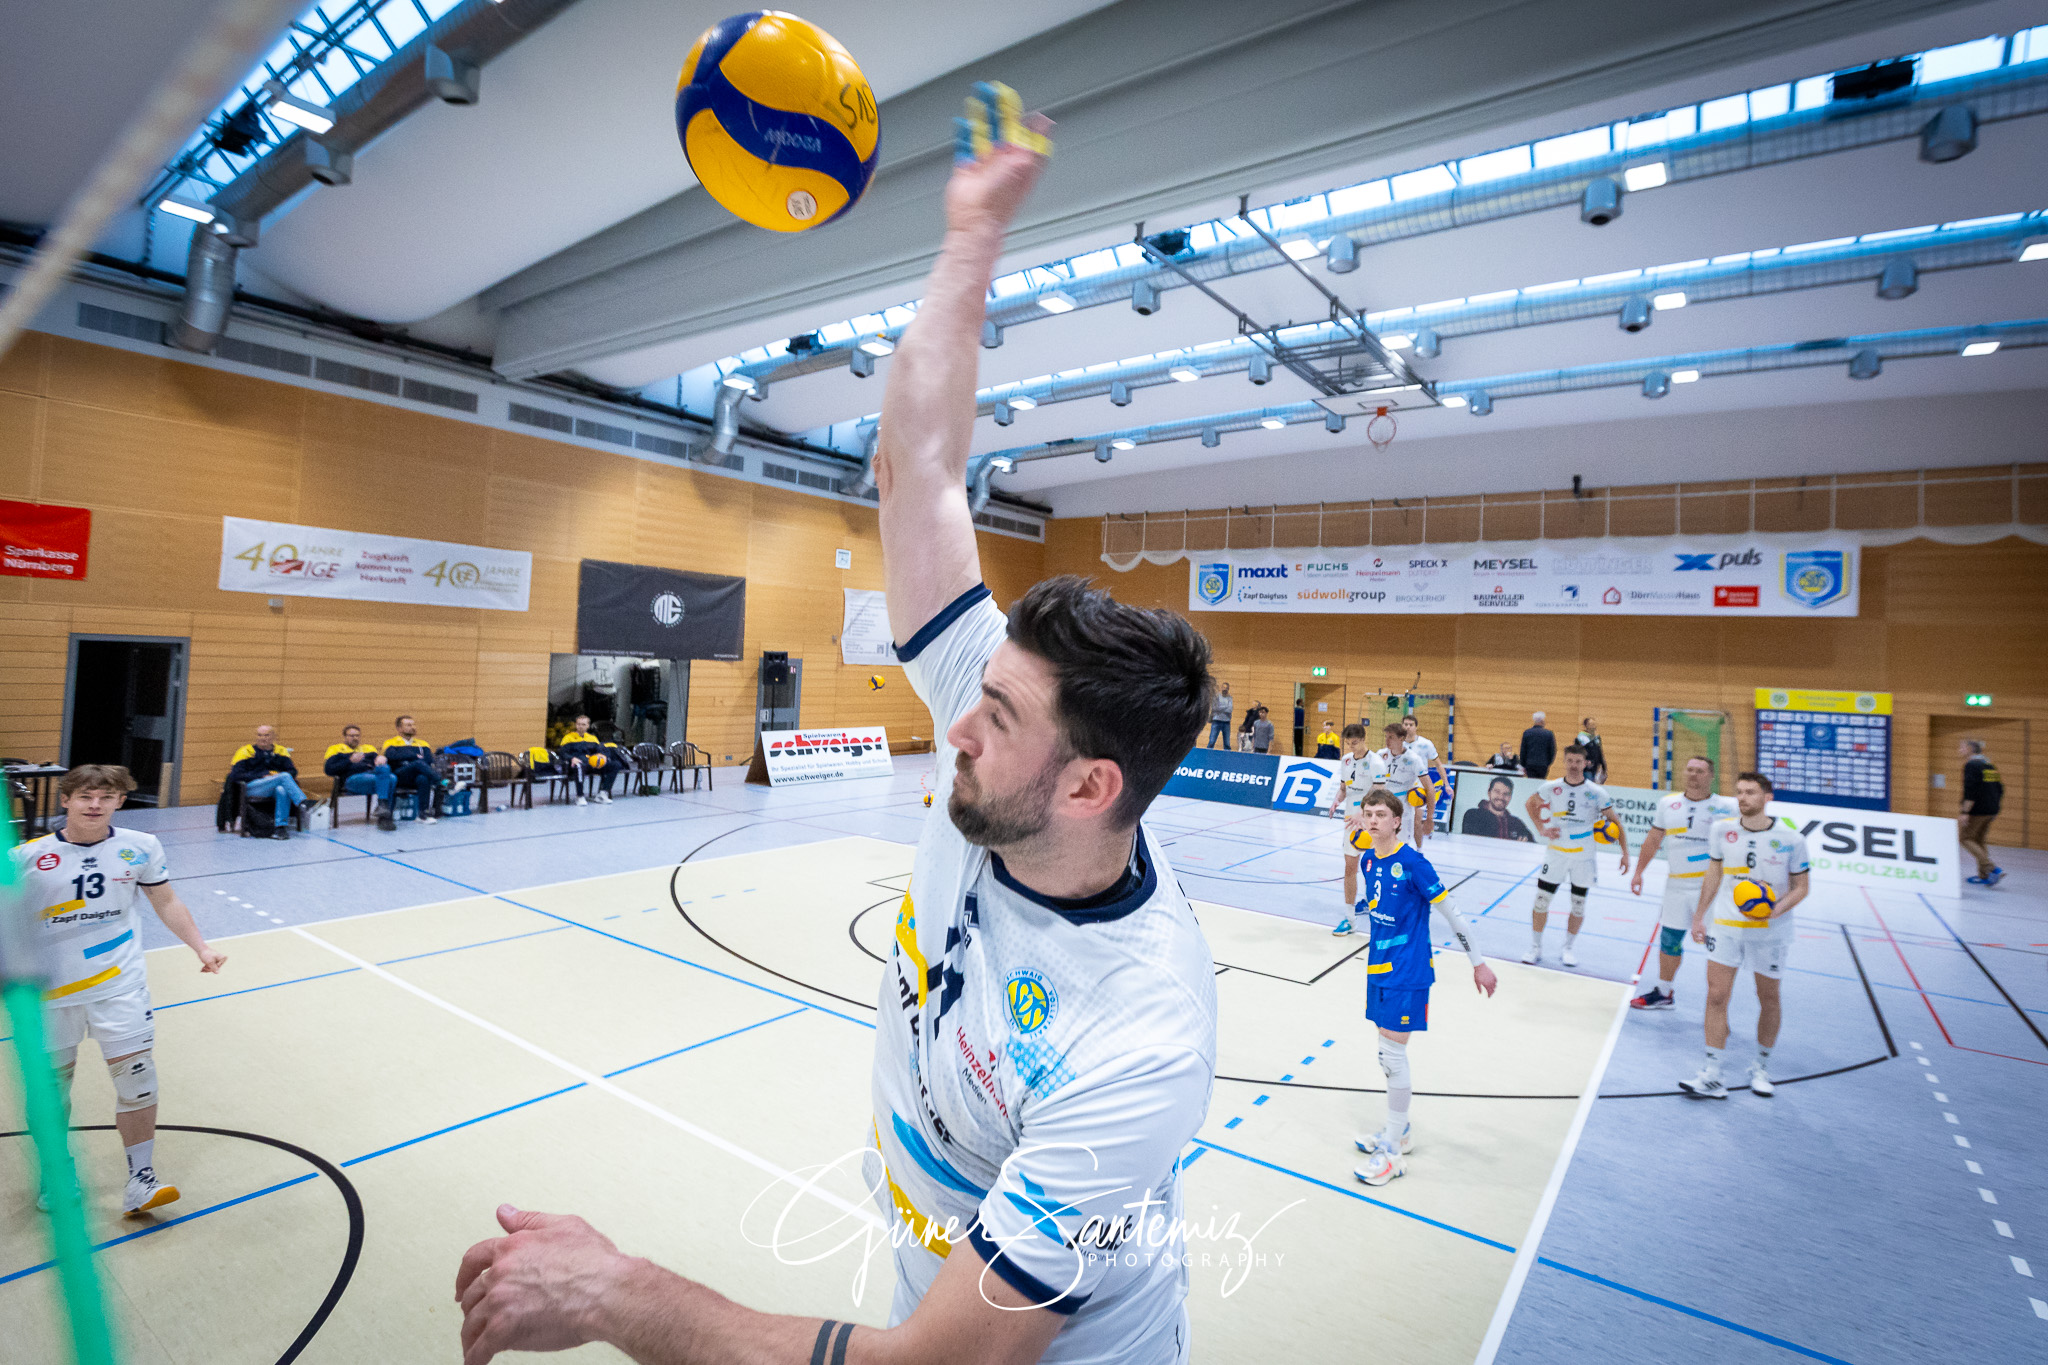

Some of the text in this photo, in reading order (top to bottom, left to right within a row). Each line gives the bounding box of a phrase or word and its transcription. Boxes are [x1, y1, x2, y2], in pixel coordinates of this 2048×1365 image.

[4, 545, 79, 560] Sparkasse
[1719, 548, 1763, 570] puls
[3, 557, 74, 574] Nürnberg
[1307, 563, 1349, 571] FUCHS
[1409, 560, 1438, 568] SPECK
[1473, 558, 1538, 569] MEYSEL
[1238, 564, 1288, 578] maxit
[1243, 592, 1288, 601] Zapf Daigfuss
[1297, 588, 1386, 603] südwollgroup
[803, 732, 842, 740] Spielwaren
[770, 732, 882, 757] schweiger
[780, 764, 807, 773] Spezialist
[1350, 770, 1356, 781] 4
[1387, 764, 1398, 775] 17
[773, 770, 844, 784] www.schweiger.de
[1205, 769, 1220, 780] OF
[1221, 771, 1272, 786] RESPECT
[1687, 815, 1694, 829] 1
[1746, 851, 1756, 868] 6
[1837, 860, 1939, 883] HOLZBAU
[72, 872, 105, 900] 13
[51, 913, 78, 924] Zapf
[961, 1066, 988, 1105] Medien
